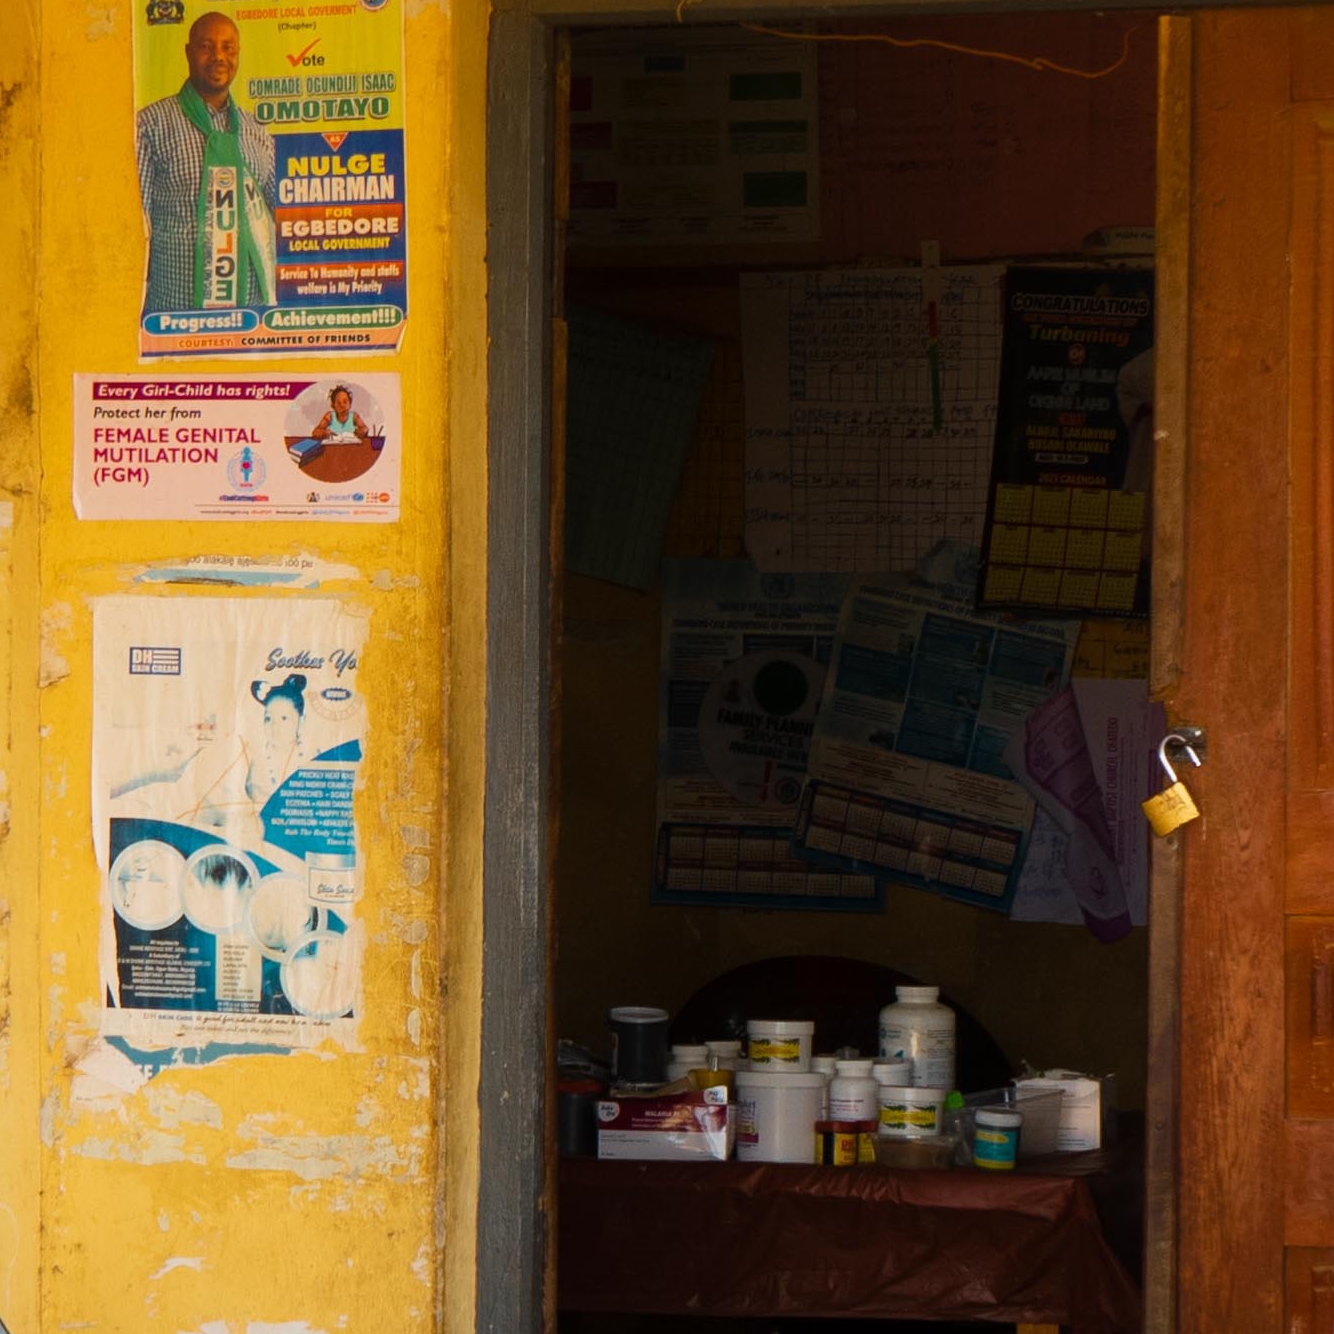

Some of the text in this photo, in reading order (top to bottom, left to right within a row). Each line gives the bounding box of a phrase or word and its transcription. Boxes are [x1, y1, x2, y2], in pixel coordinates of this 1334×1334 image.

[236, 9, 278, 21] EGBEDORE
[280, 7, 305, 18] LOCAL
[278, 21, 316, 32] (Chapter)
[249, 73, 395, 96] COMRADE OGUNDIJI ISAAC
[255, 97, 390, 123] OMOTAYO
[287, 154, 386, 177] NULGE
[279, 175, 395, 204] CHAIRMAN
[325, 207, 352, 218] FOR
[281, 218, 400, 237] EGBEDORE
[289, 237, 390, 252] LOCAL GOVERNMENT
[1011, 292, 1150, 318] CONGRATULATIONS
[160, 307, 397, 332] Progress!! Achievement!!!
[241, 335, 304, 346] COMMITTEE
[307, 334, 321, 344] OF
[324, 333, 371, 344] FRIENDS
[99, 384, 291, 400] Every Girl-Child has rights!
[94, 406, 201, 421] Protect her from
[94, 428, 261, 444] FEMALE GENITAL
[94, 448, 219, 463] MUTILATION
[94, 467, 150, 487] (FGM)
[132, 648, 324, 671] DH Soothes
